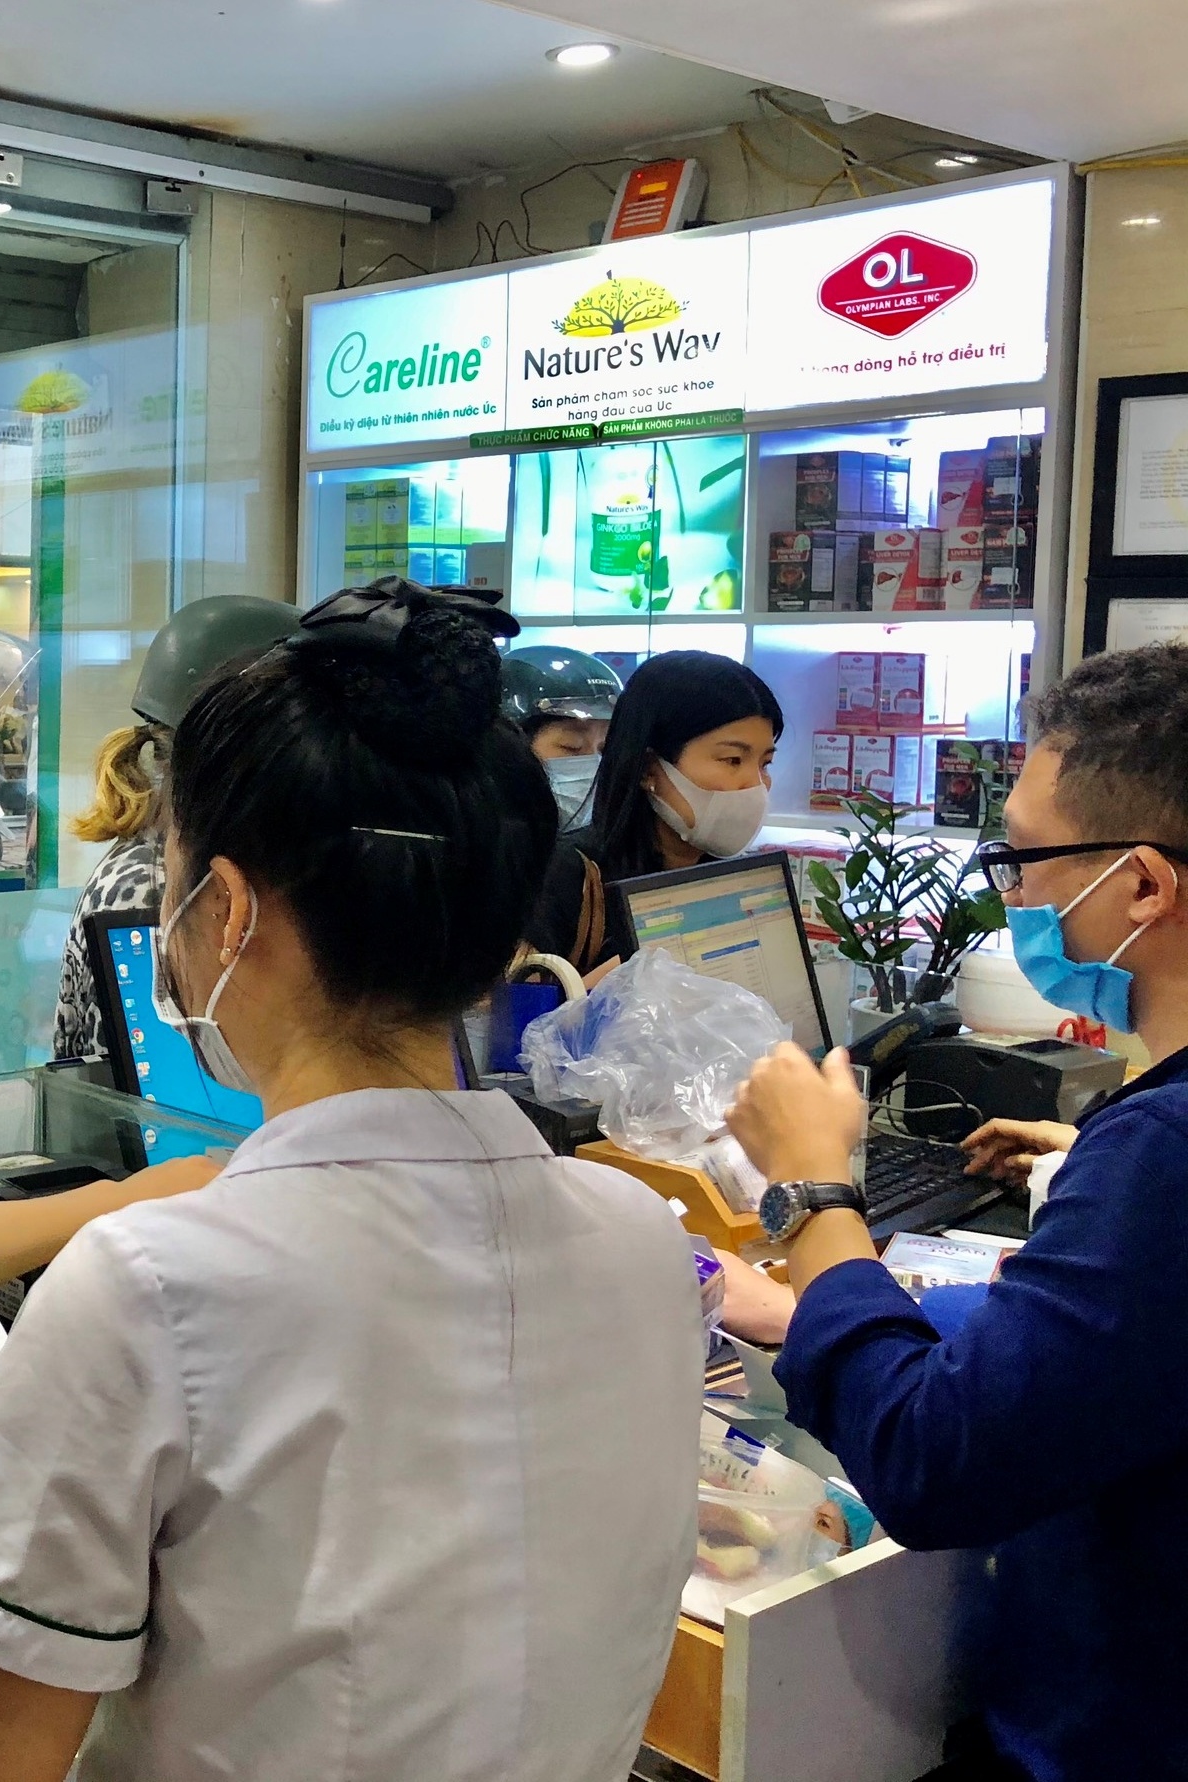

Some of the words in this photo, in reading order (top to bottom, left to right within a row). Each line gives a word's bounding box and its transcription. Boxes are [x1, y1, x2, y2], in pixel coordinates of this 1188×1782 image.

[863, 248, 924, 288] OL
[845, 301, 891, 315] OLYMPIAN
[894, 296, 920, 308] LABS.
[524, 338, 644, 381] Nature's
[854, 358, 893, 372] dòng
[922, 351, 944, 367] trợ
[989, 342, 1006, 359] trị
[422, 409, 449, 421] nhiên
[562, 427, 590, 439] NĂNG
[596, 522, 628, 534] GINKGO
[587, 678, 618, 687] HONDA
